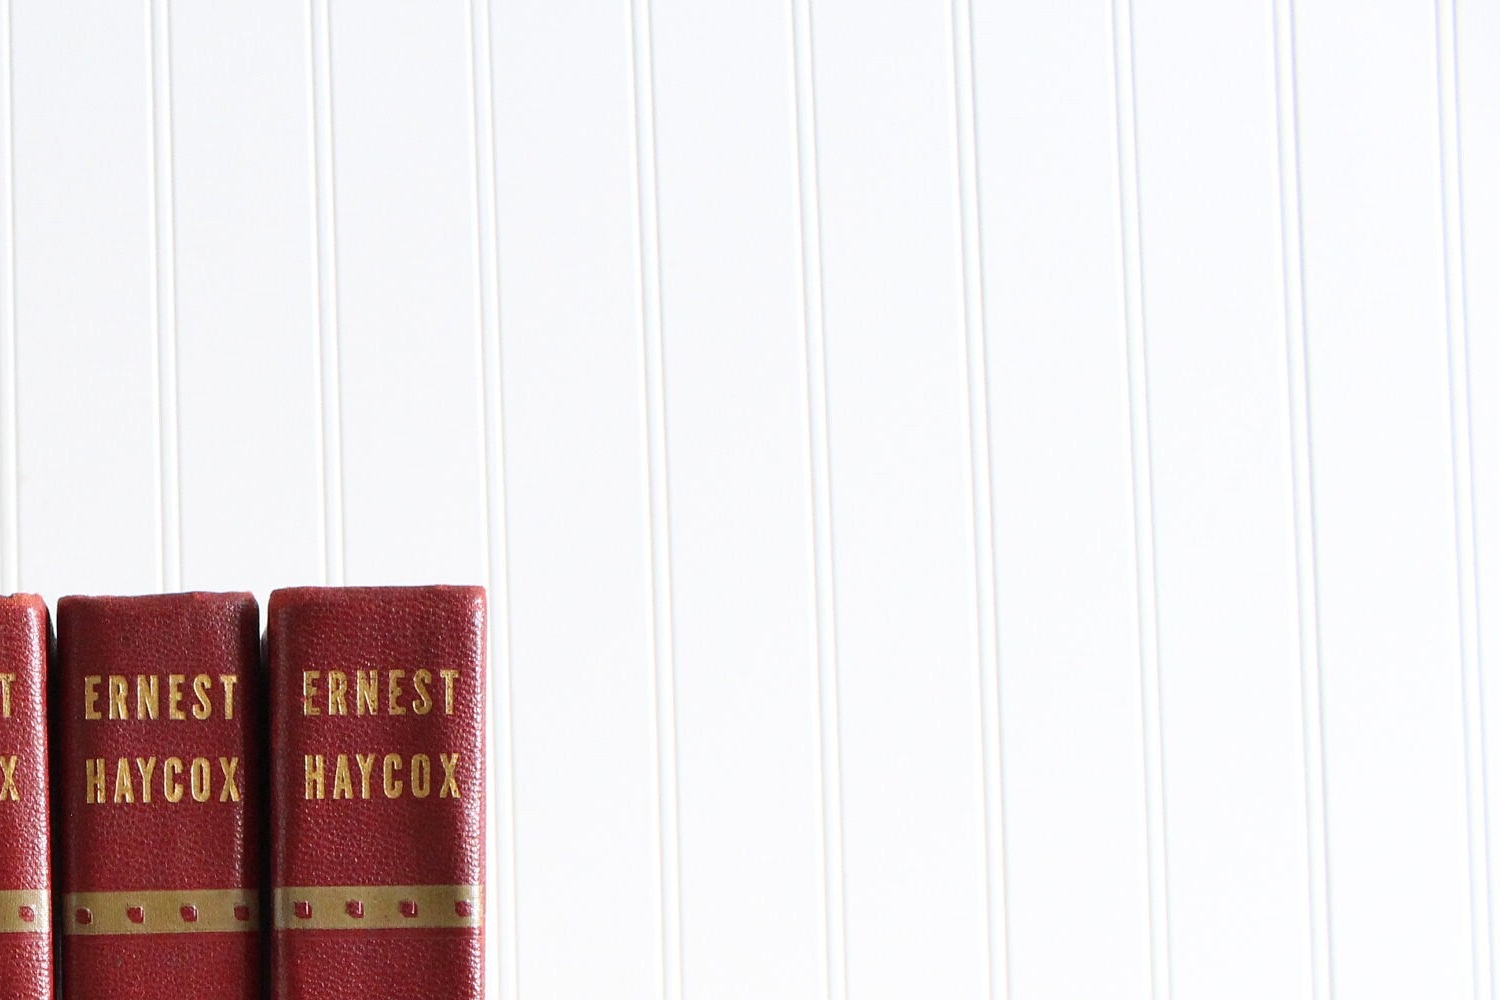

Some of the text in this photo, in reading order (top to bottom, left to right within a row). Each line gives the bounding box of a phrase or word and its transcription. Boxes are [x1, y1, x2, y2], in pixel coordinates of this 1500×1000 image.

[84, 674, 238, 721] ERNEST
[302, 668, 460, 716] ERNEST
[85, 756, 242, 804] HAYCOX
[304, 752, 462, 800] HAYCOX
